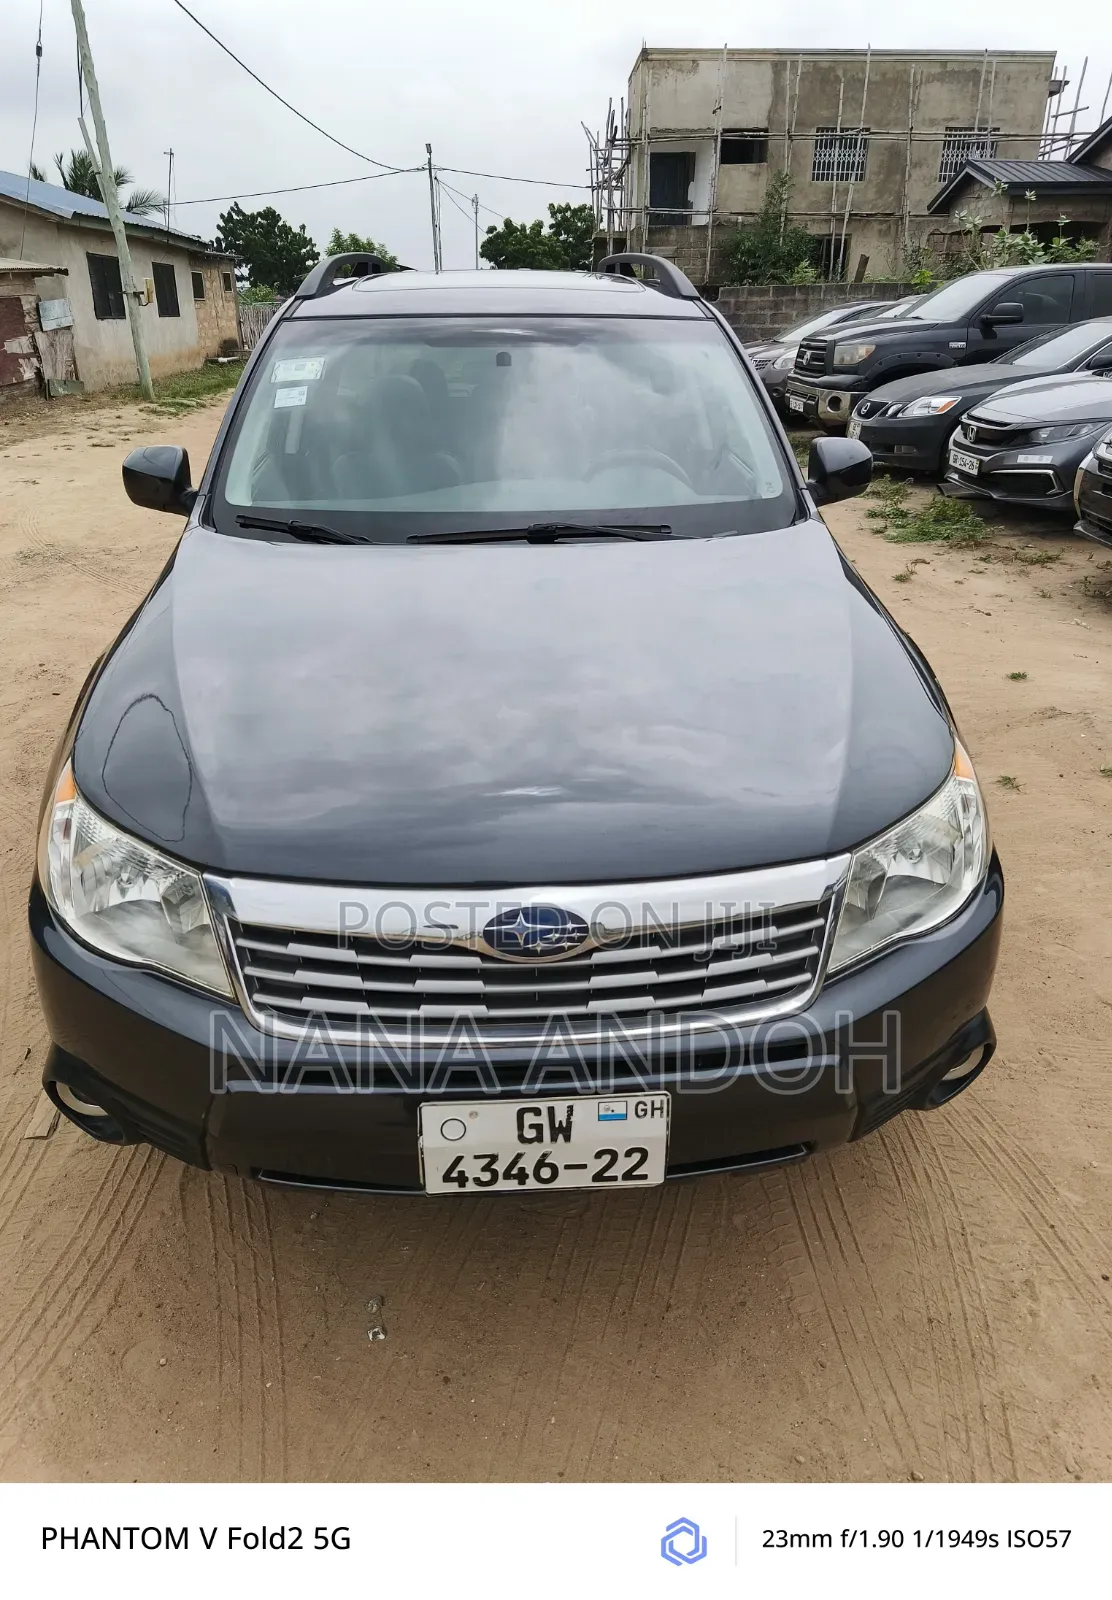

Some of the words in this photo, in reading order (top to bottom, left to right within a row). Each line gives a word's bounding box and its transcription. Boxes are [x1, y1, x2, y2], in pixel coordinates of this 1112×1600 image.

[516, 1104, 574, 1145] GW
[634, 1099, 665, 1119] GH
[441, 1146, 649, 1188] 4346-22
